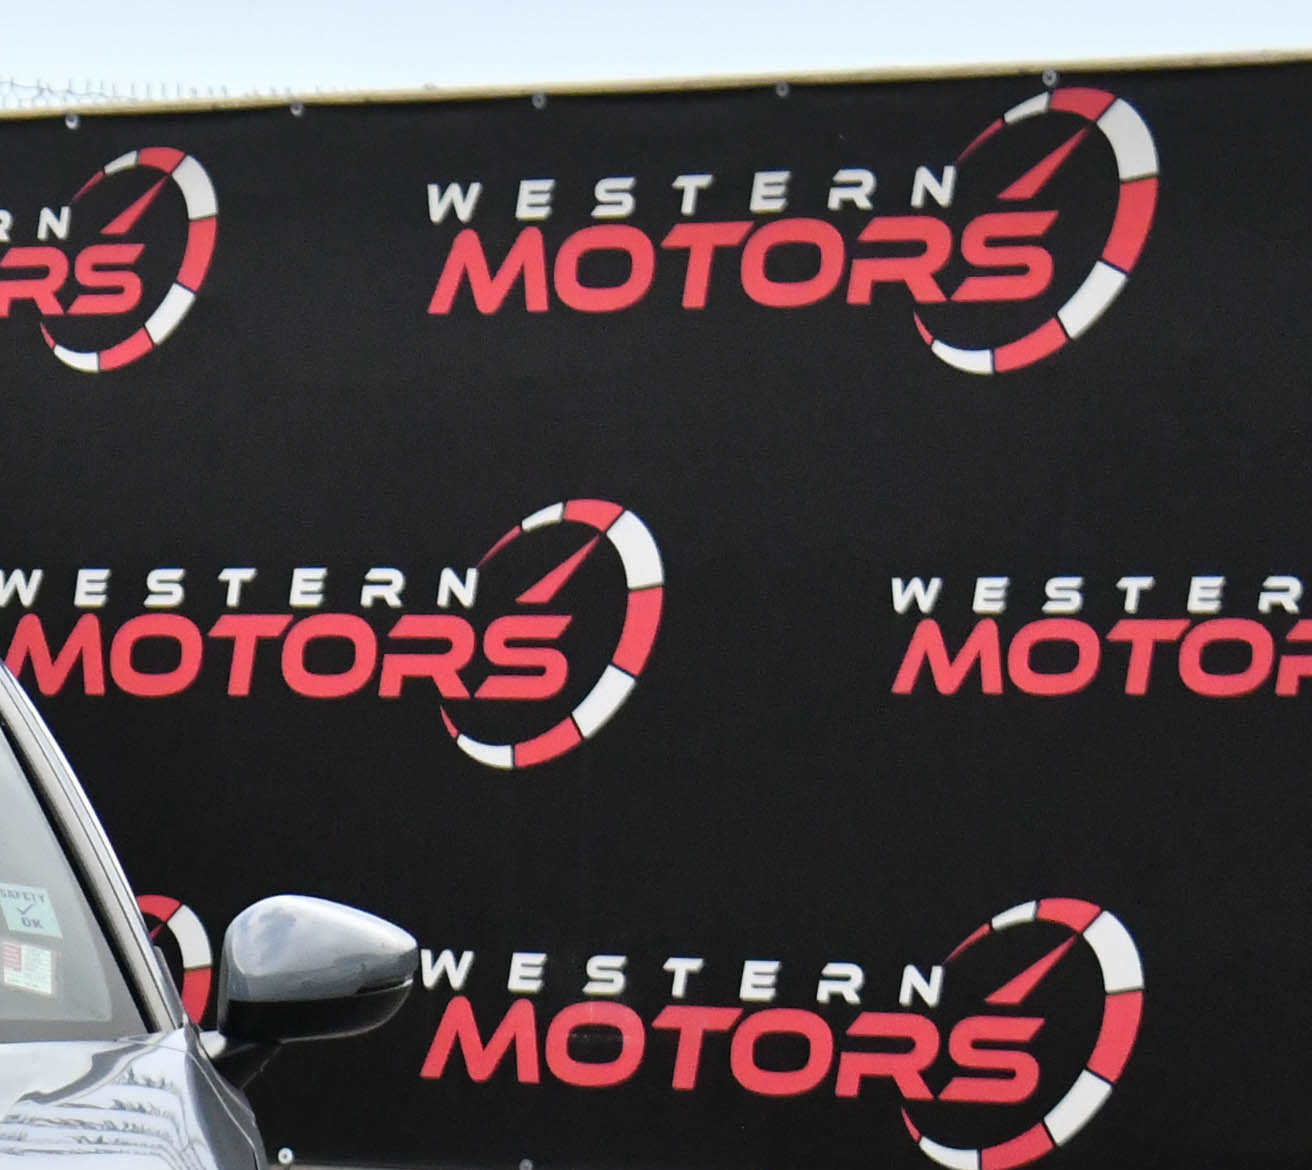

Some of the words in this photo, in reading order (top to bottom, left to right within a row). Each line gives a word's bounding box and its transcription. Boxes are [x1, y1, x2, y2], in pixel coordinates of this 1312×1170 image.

[427, 165, 957, 224] WESTERN
[427, 210, 1059, 316] MOTORS
[891, 575, 1303, 614] WESTER
[4, 612, 573, 701] MOTORS
[420, 948, 944, 1007] WESTERN
[420, 995, 1045, 1104] MOTORS
